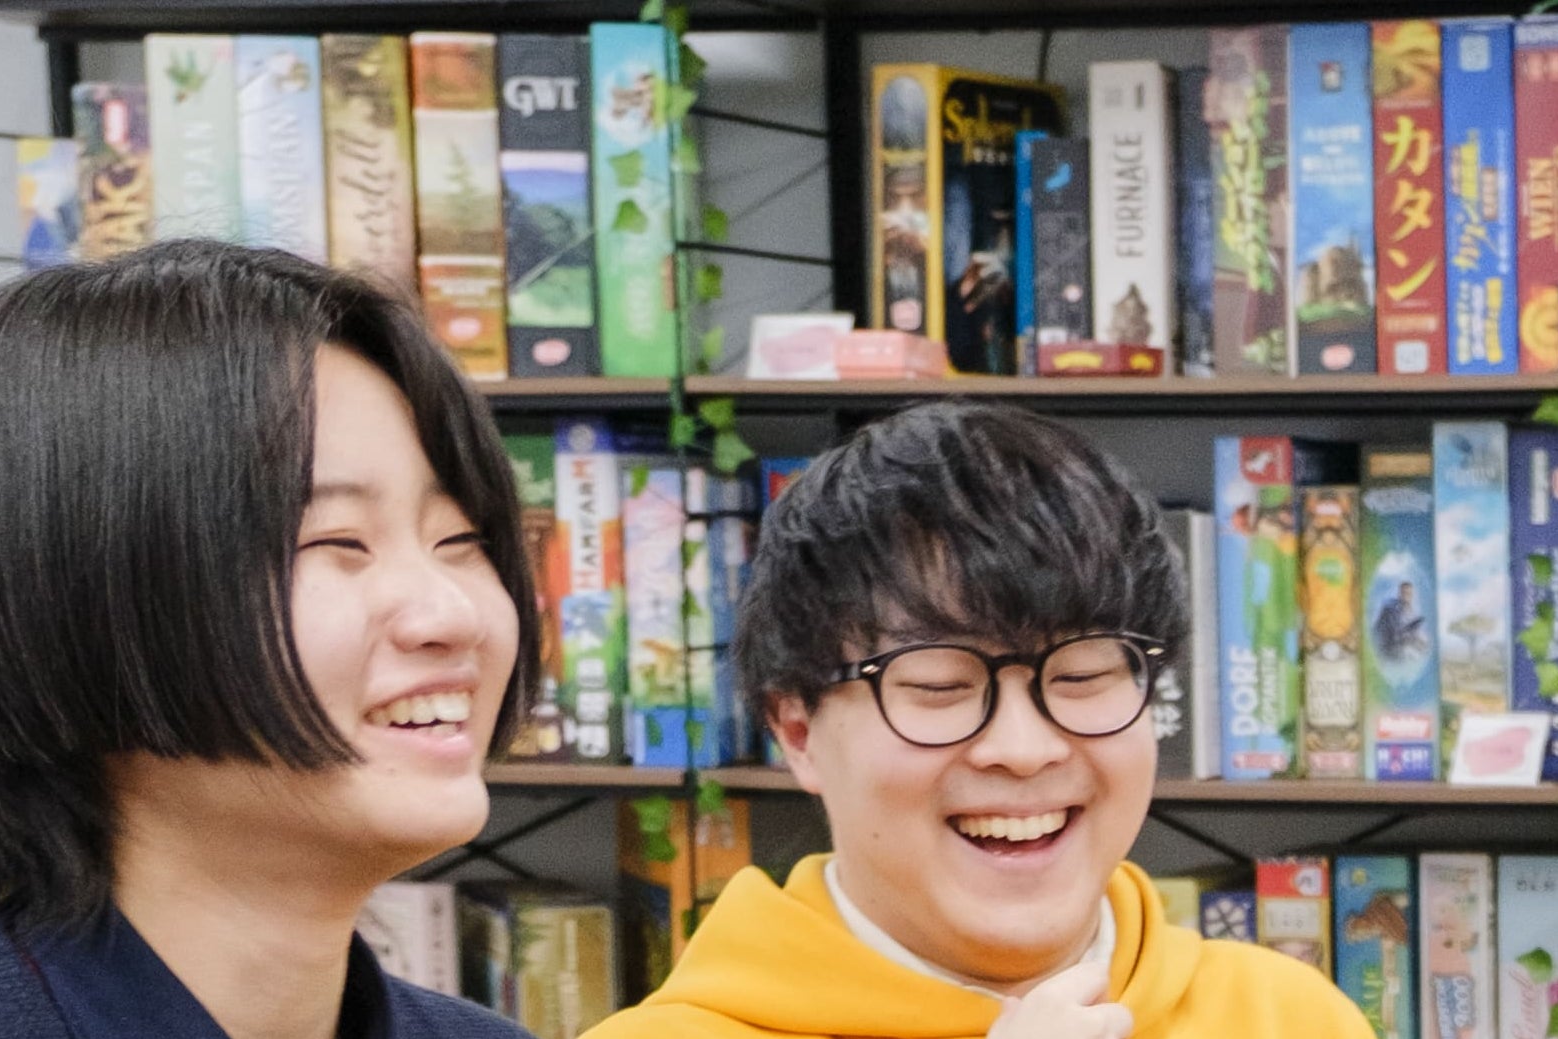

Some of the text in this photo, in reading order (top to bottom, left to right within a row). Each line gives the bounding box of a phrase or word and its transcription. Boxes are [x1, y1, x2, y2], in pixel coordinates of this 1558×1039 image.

[503, 76, 580, 117] GWT
[1115, 131, 1143, 258] FURNACE
[1379, 114, 1439, 302] カタン
[1528, 158, 1554, 241] WIEN
[1229, 643, 1258, 736] DORF
